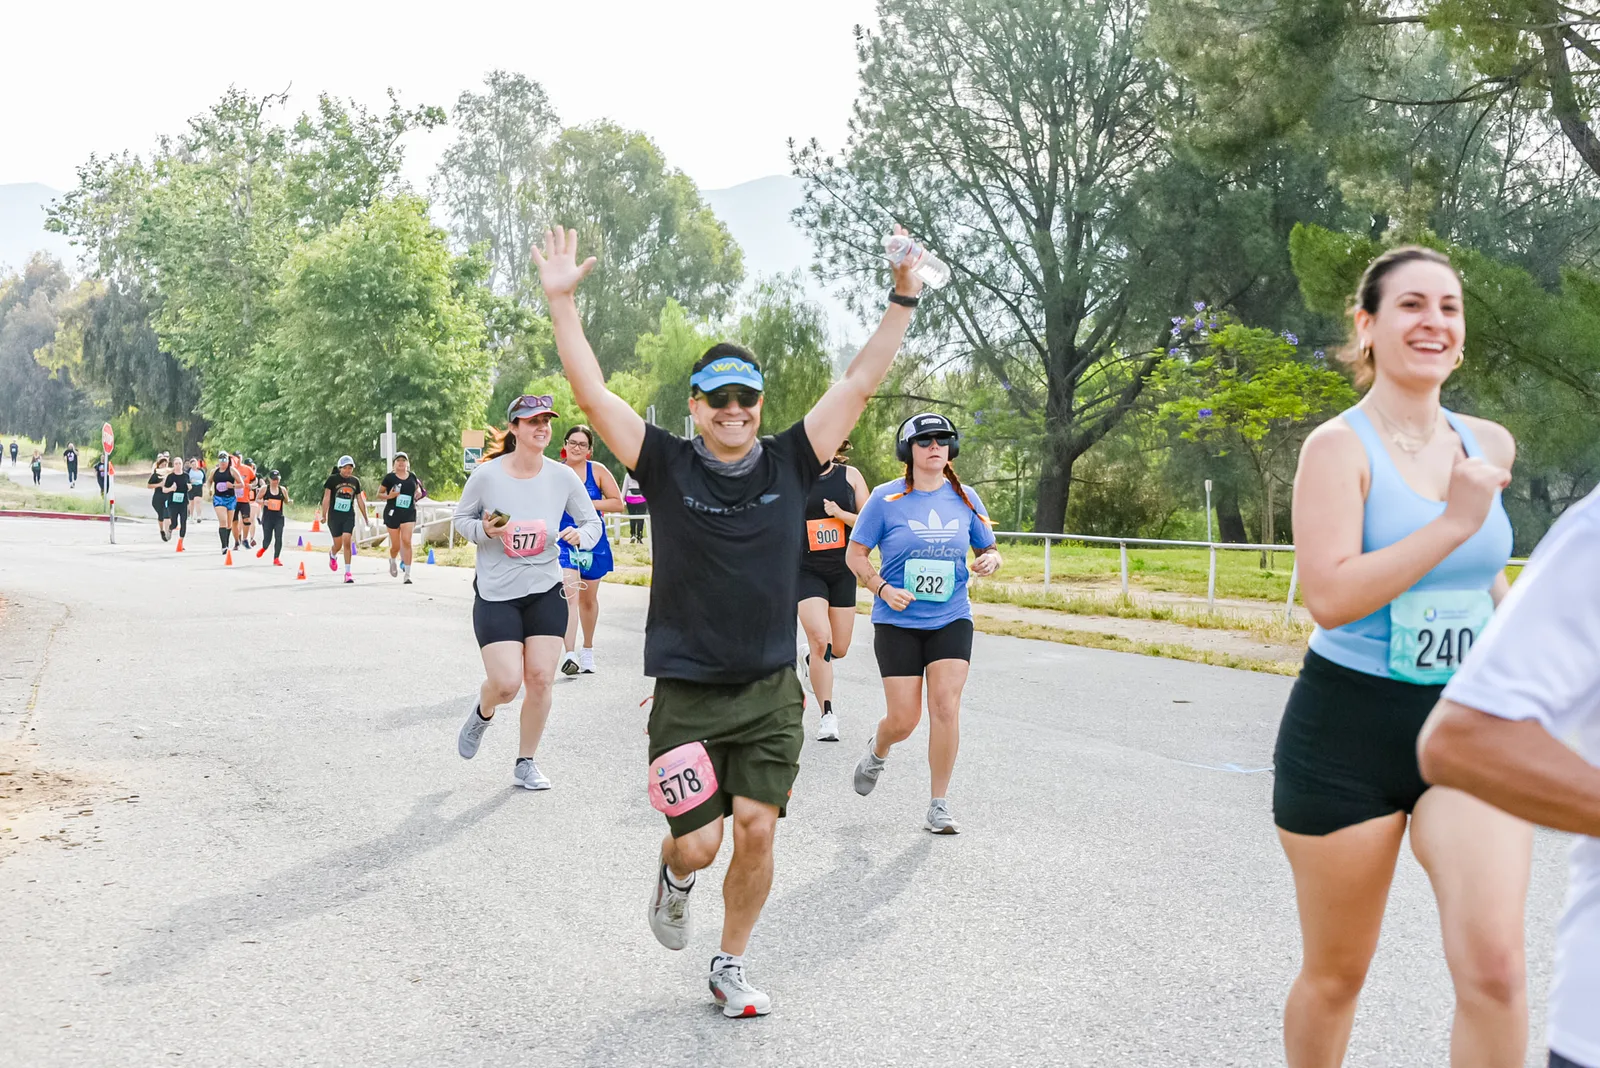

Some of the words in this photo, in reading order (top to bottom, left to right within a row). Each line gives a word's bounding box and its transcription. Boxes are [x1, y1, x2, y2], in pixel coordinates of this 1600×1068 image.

[512, 533, 538, 550] 577
[816, 528, 839, 545] 900
[910, 545, 963, 558] adidas
[915, 575, 944, 594] 232
[1416, 627, 1474, 668] 240
[658, 767, 702, 805] 578
